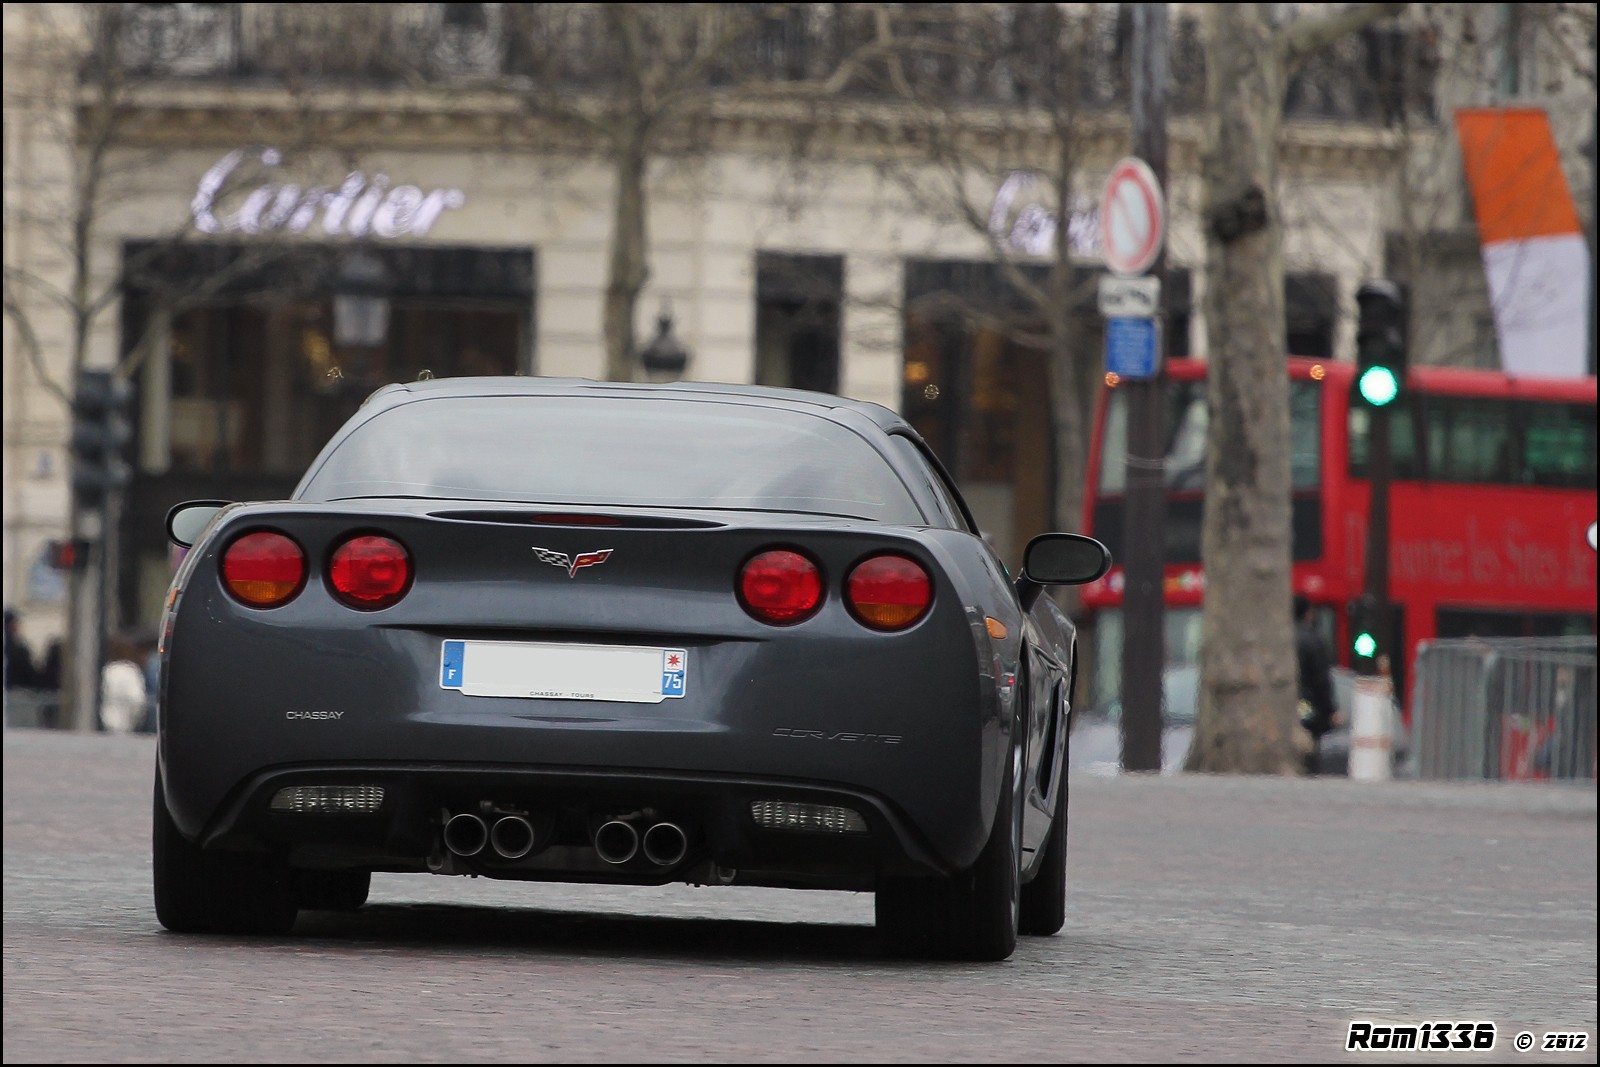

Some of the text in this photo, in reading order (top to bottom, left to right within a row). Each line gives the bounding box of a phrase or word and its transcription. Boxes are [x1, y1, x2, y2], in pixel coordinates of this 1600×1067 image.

[191, 147, 465, 237] Cartier
[447, 668, 457, 680] F
[663, 673, 682, 689] 75
[285, 711, 345, 720] CHASSAY
[772, 727, 903, 745] CORVETTE
